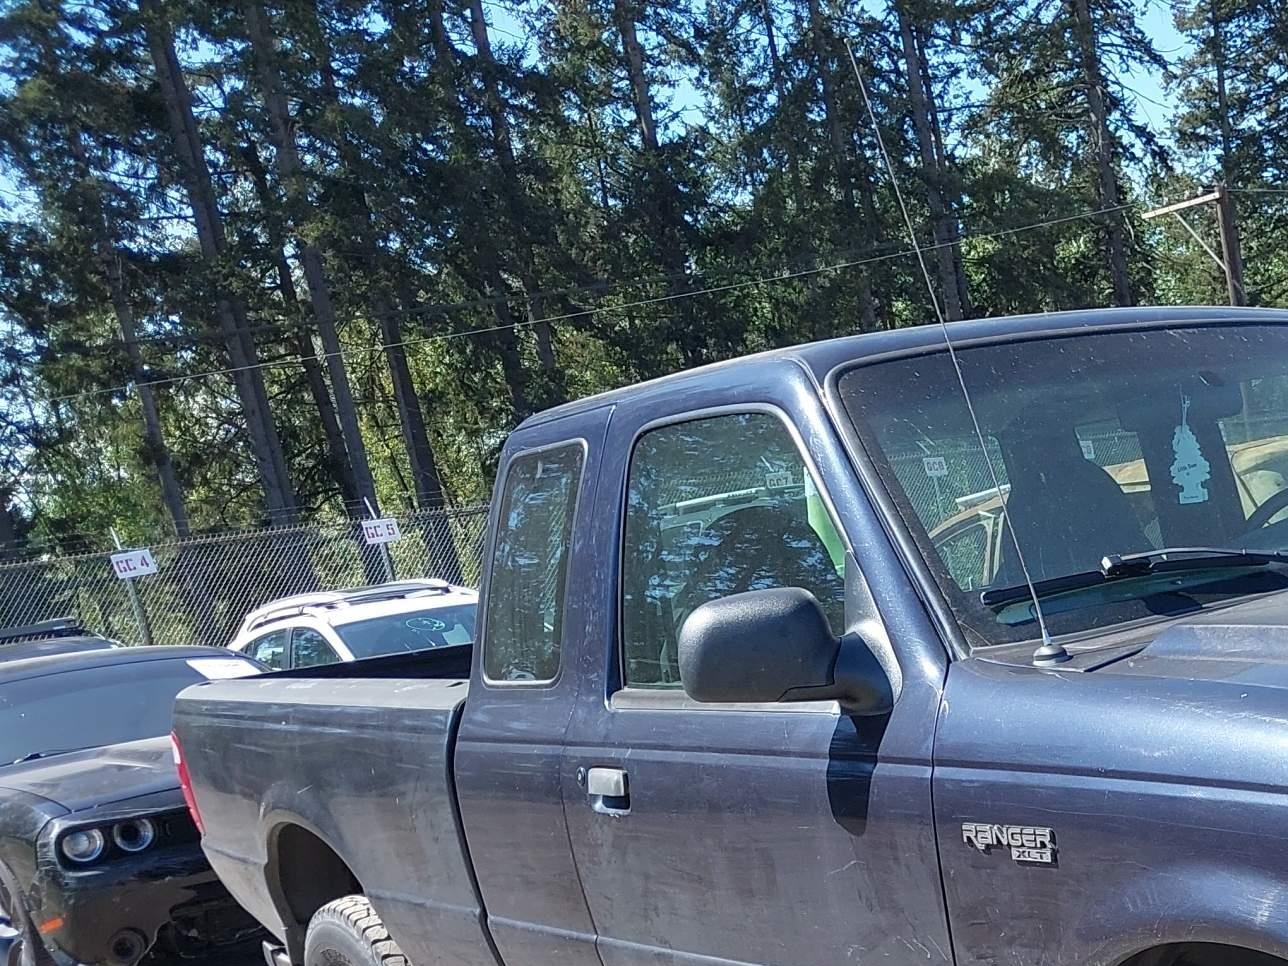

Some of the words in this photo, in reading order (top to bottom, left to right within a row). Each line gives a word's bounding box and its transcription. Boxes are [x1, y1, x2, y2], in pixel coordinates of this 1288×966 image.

[366, 525, 383, 539] GC
[387, 523, 396, 535] 5
[115, 558, 135, 573] GC
[140, 555, 149, 568] 4
[962, 822, 1054, 850] RANGER
[1014, 849, 1050, 861] XLT
